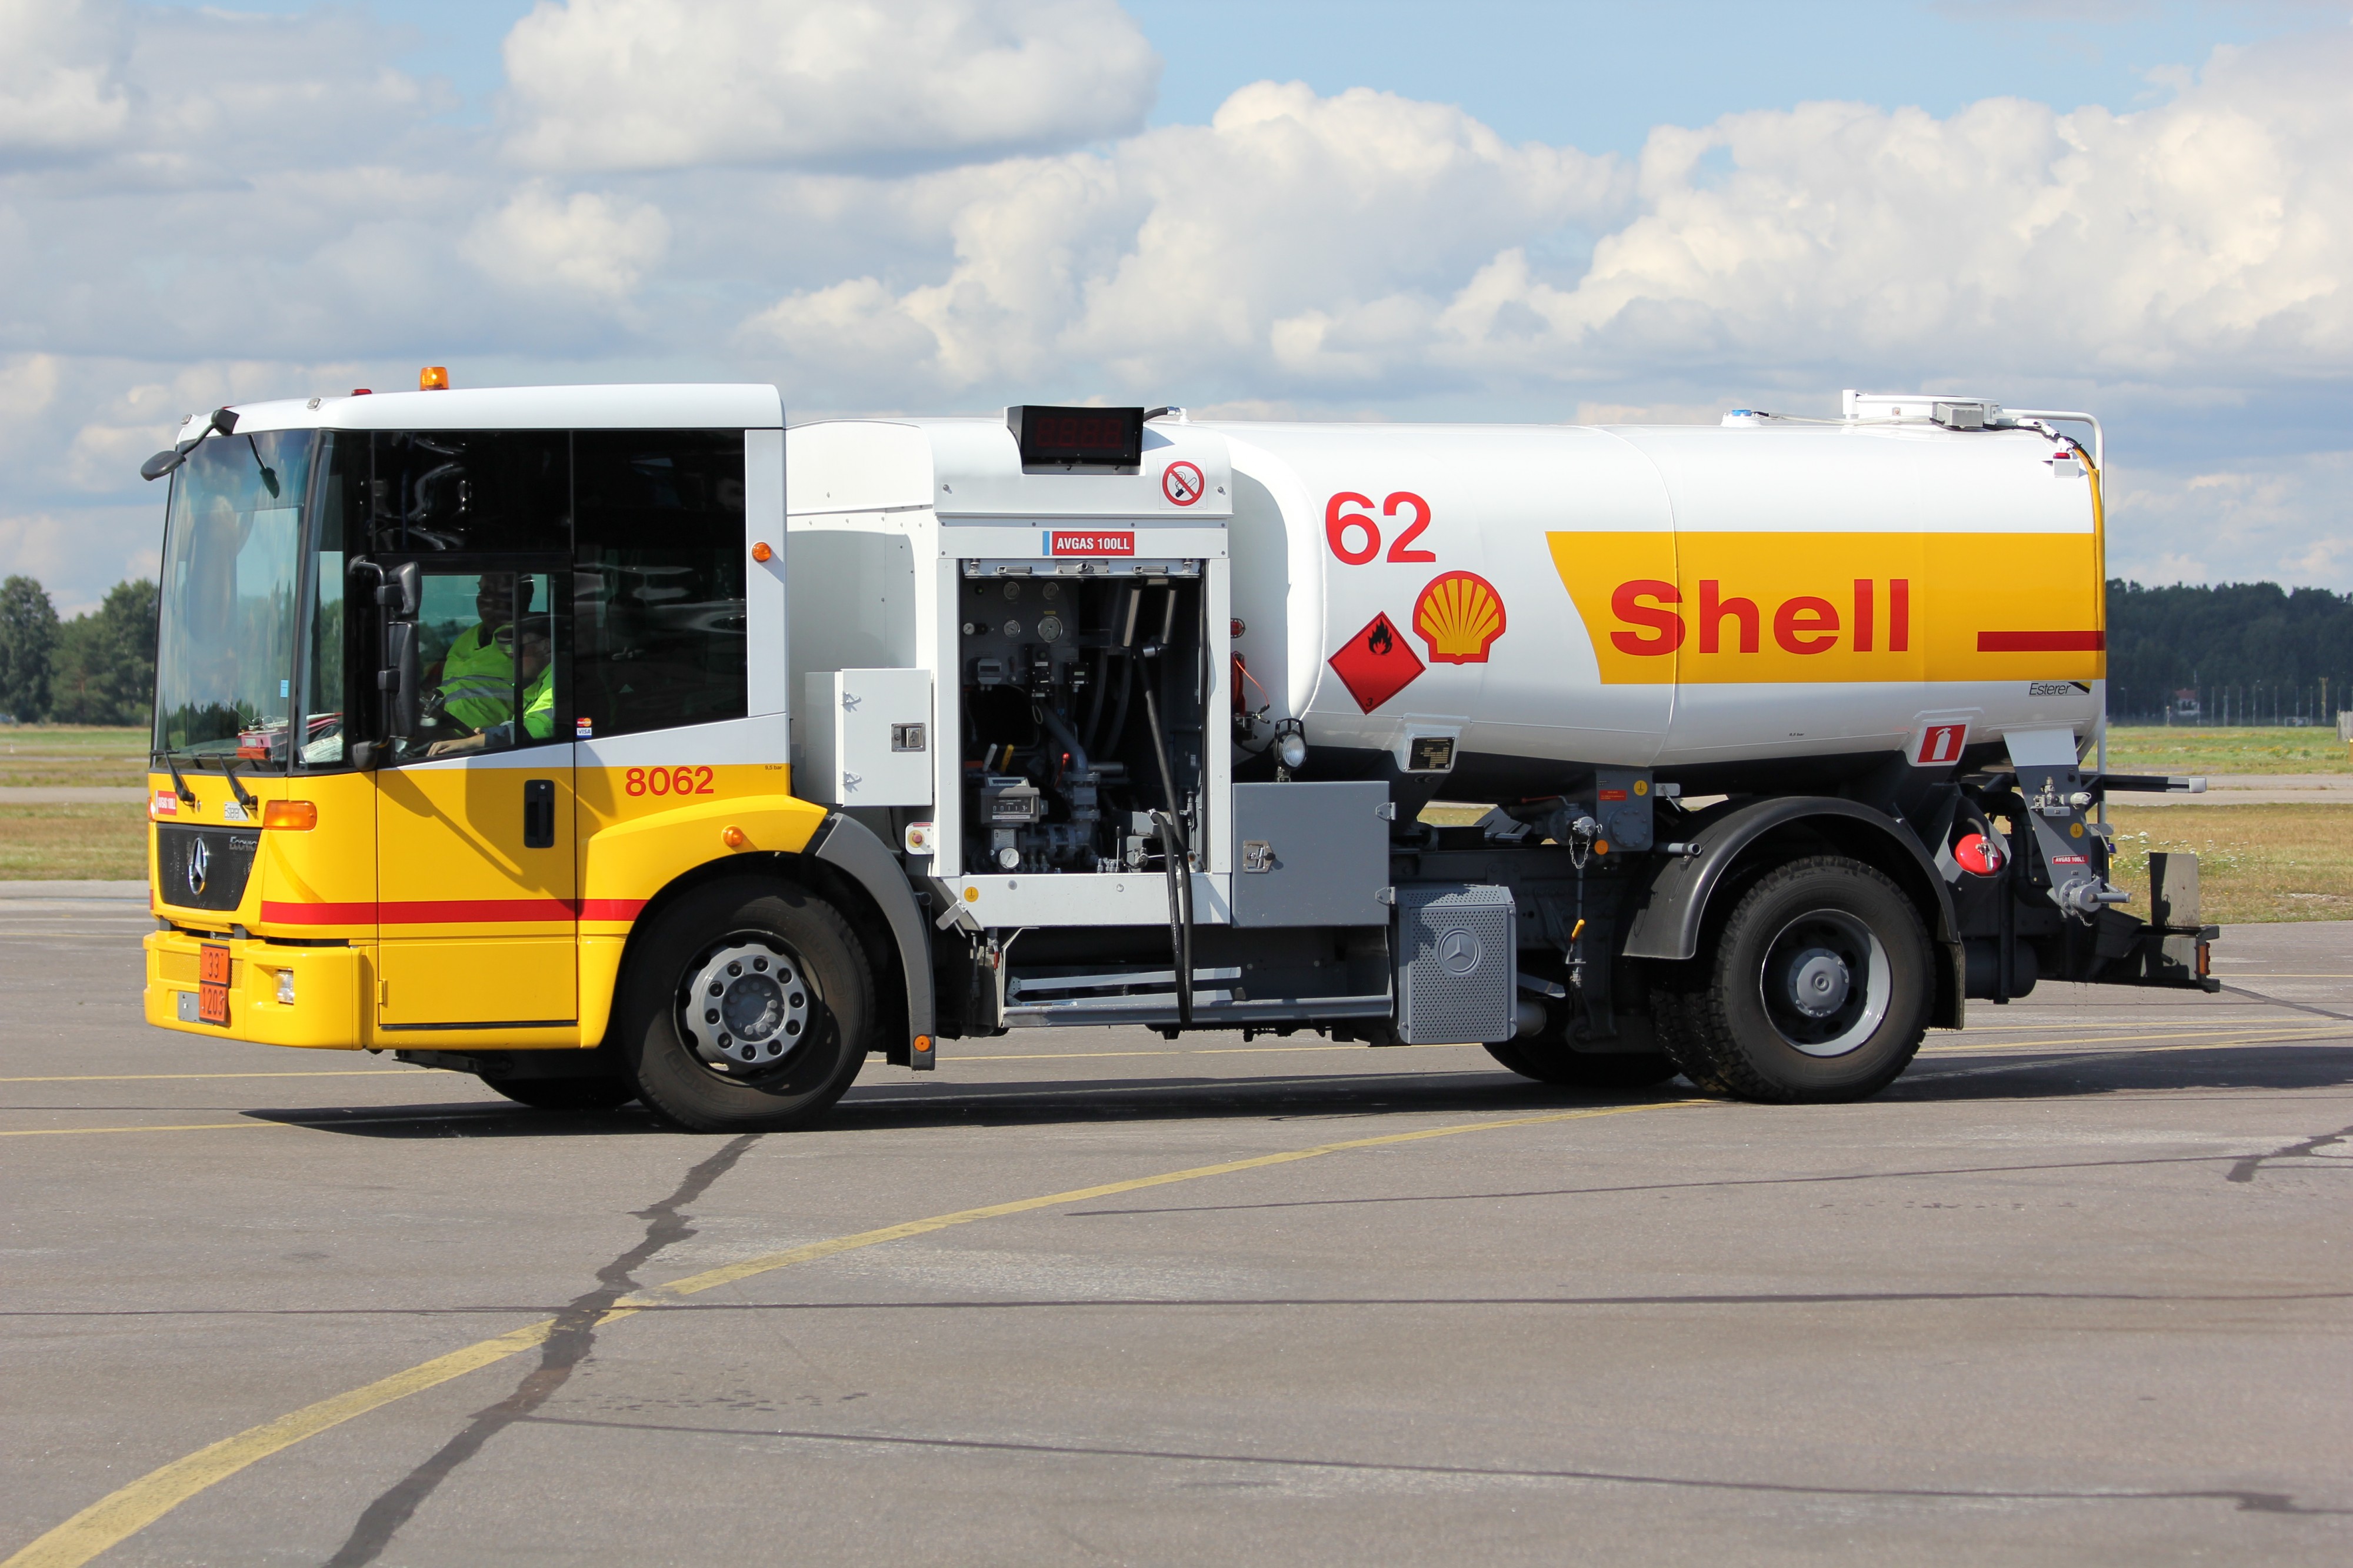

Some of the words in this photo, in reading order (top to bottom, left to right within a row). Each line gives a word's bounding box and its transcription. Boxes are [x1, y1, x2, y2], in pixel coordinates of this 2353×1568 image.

[1325, 491, 1436, 565] 62
[1056, 537, 1094, 550] AVGAS
[1097, 538, 1130, 550] 100LL
[1609, 578, 1909, 656] Shell
[1365, 698, 1373, 707] 3
[2029, 683, 2071, 695] Esterer
[625, 766, 714, 796] 8062
[208, 952, 219, 979] 33
[202, 987, 223, 1016] 1203
